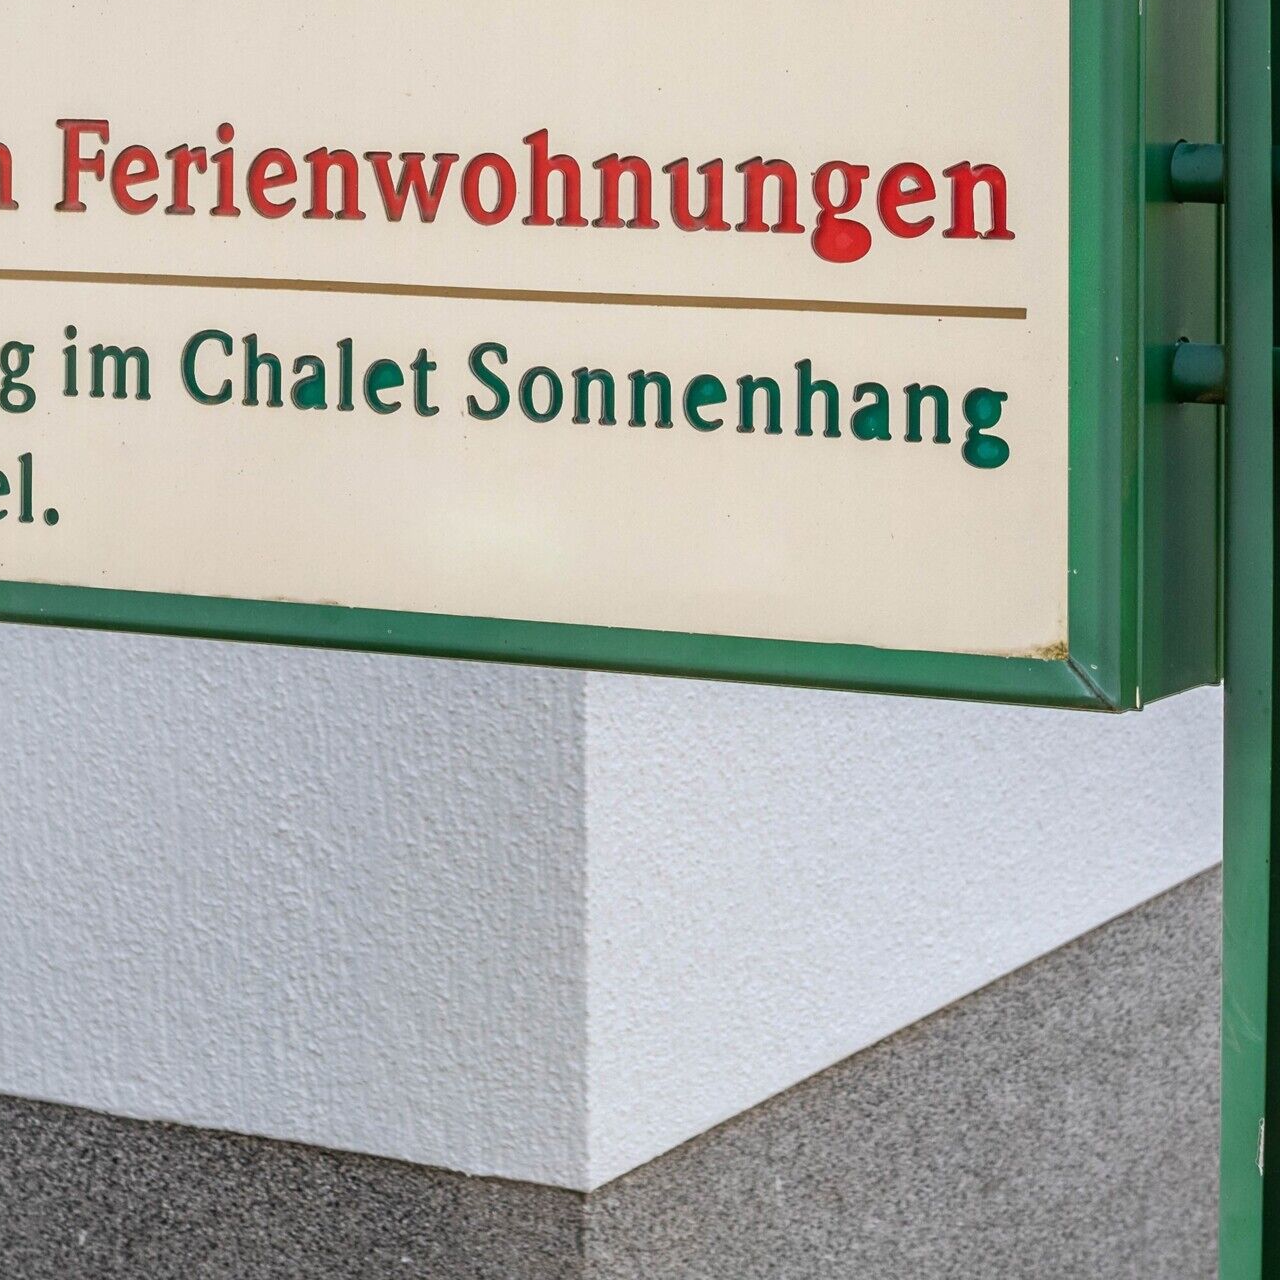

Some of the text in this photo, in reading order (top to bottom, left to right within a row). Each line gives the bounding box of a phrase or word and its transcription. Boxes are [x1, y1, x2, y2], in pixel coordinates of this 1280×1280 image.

[54, 118, 1017, 264] Ferienwohnungen
[62, 328, 152, 401] im
[181, 329, 440, 417] Chalet
[466, 341, 1011, 469] Sonnenhang
